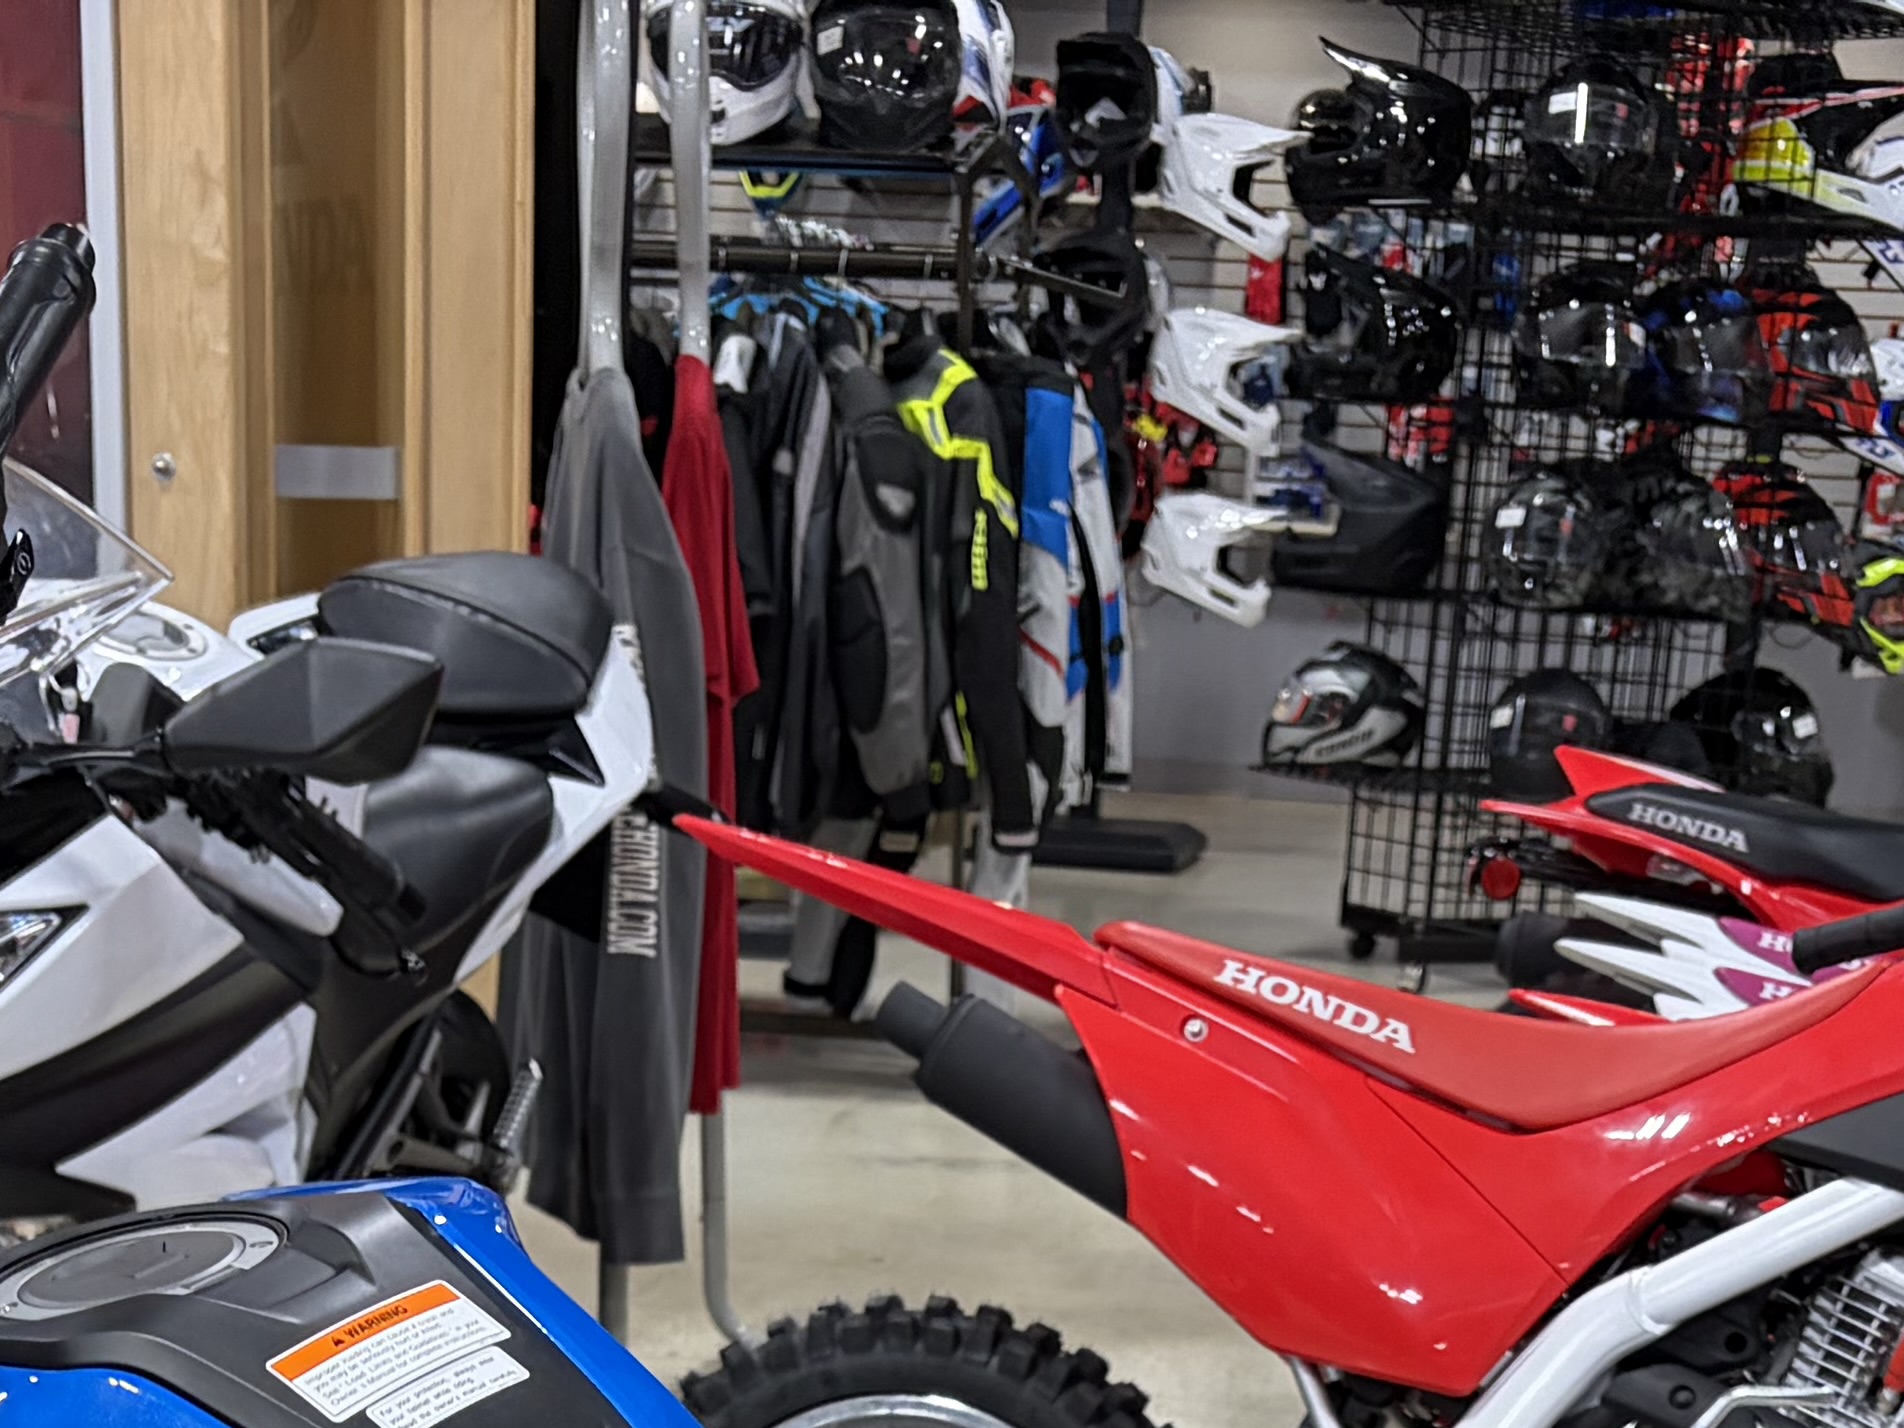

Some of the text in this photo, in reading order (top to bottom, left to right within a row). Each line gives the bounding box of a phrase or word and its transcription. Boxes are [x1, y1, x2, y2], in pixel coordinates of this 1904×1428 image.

[1628, 802, 1750, 852] HONDA
[1213, 959, 1416, 1055] HONDA
[347, 1304, 409, 1340] WARNING
